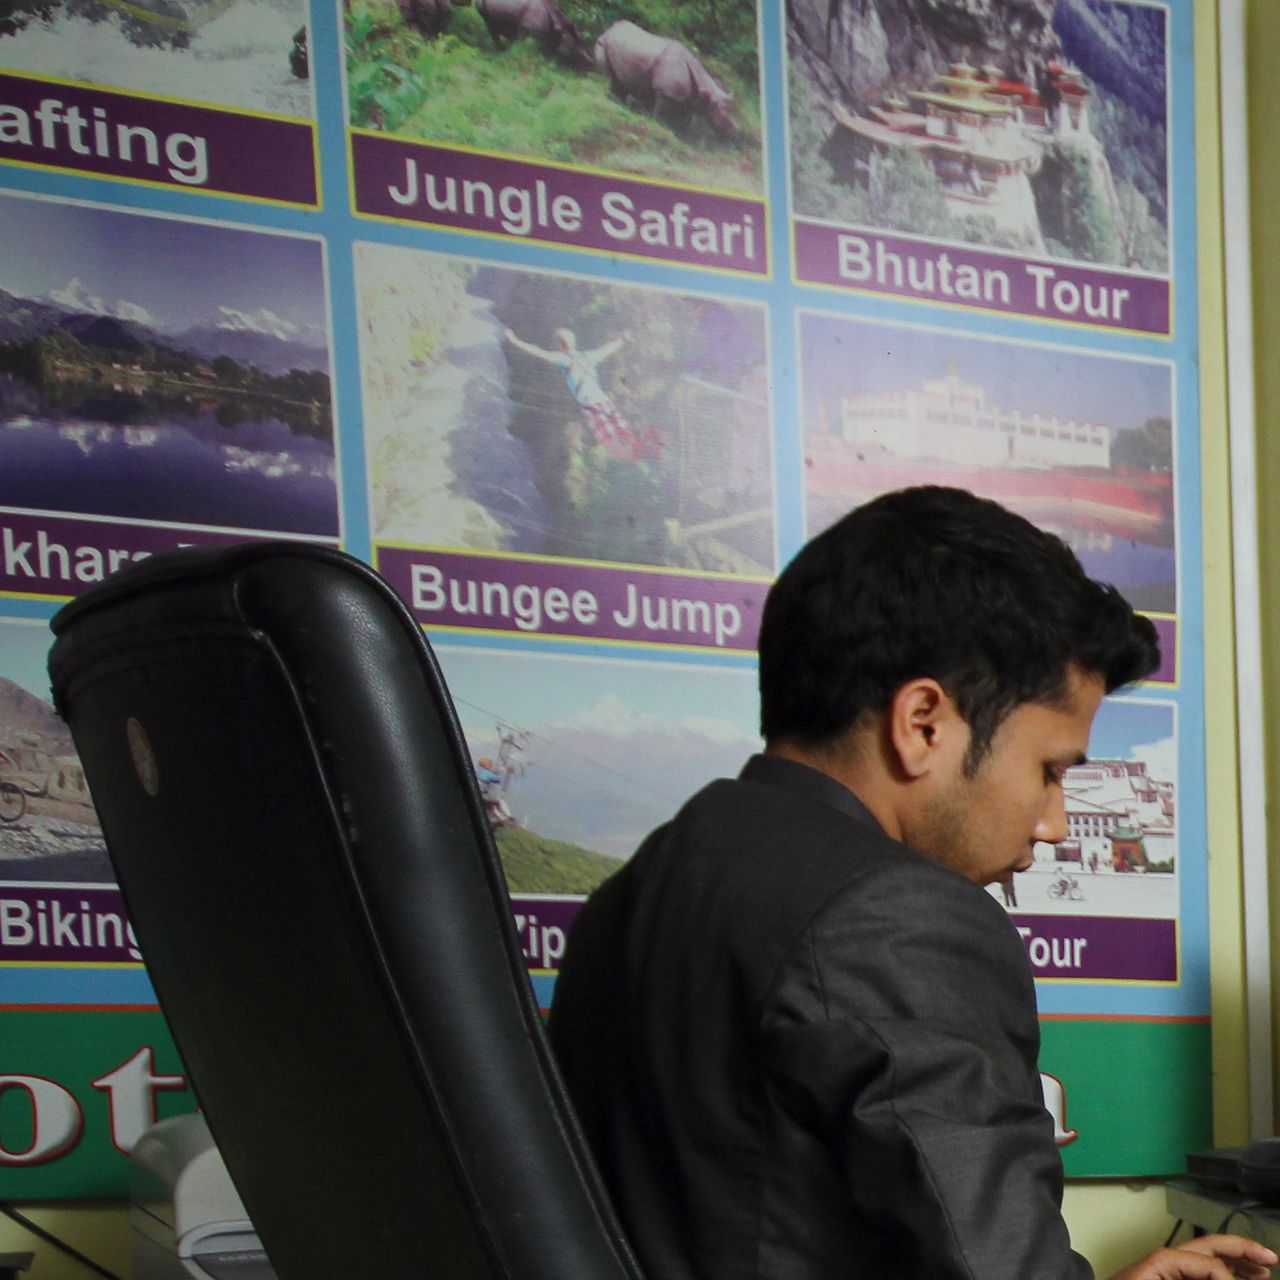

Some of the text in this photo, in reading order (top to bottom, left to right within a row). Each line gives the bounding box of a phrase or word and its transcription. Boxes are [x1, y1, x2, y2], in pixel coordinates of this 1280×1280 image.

[0, 99, 208, 184] afting
[388, 158, 755, 259] Jungle Safari
[837, 234, 1130, 320] Bhutan Tour
[3, 527, 152, 583] khar
[410, 564, 743, 646] Bungee Jump
[0, 1046, 200, 1167] ot
